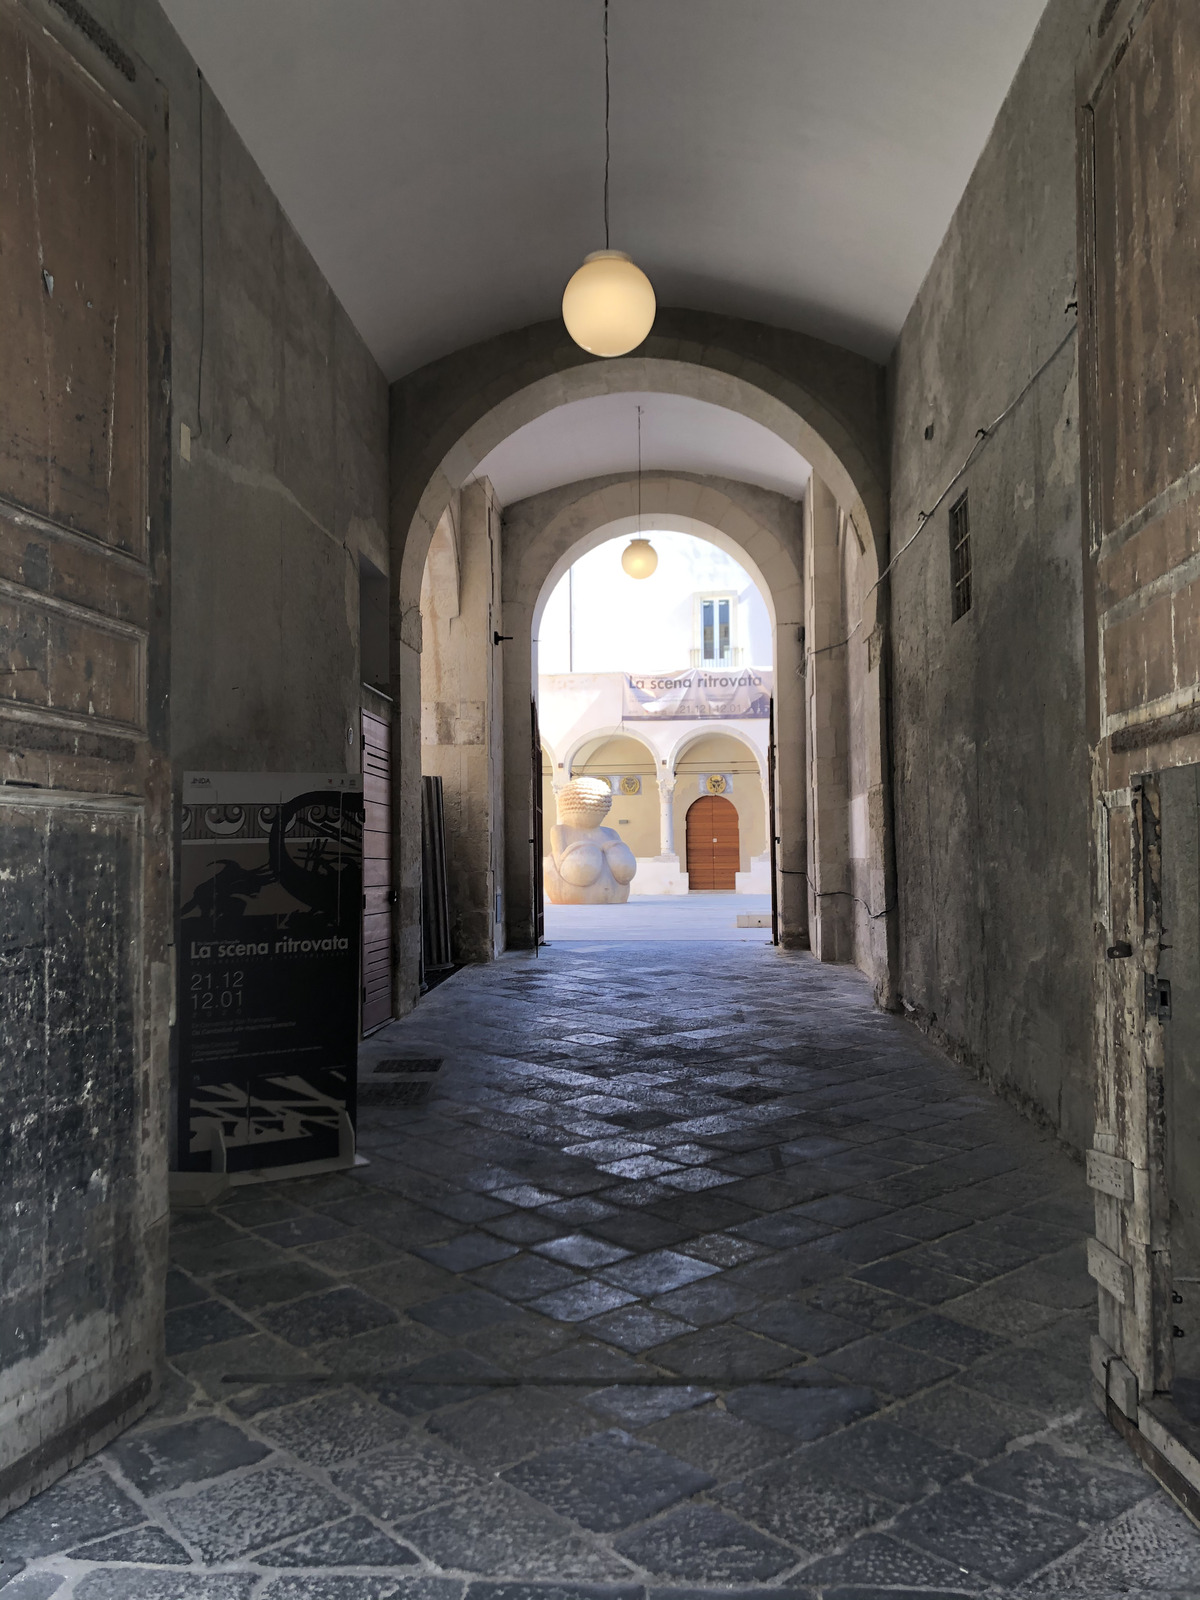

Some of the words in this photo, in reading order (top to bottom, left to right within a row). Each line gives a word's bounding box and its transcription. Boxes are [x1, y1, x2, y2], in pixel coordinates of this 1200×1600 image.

[629, 676, 645, 690] La
[650, 679, 692, 690] scena
[697, 673, 763, 688] ritrovata
[679, 704, 706, 714] 21.12
[190, 941, 211, 959] La
[217, 942, 269, 958] scena
[275, 935, 349, 955] ritrovata
[190, 970, 244, 990] 21.12
[190, 990, 242, 1010] 12.01
